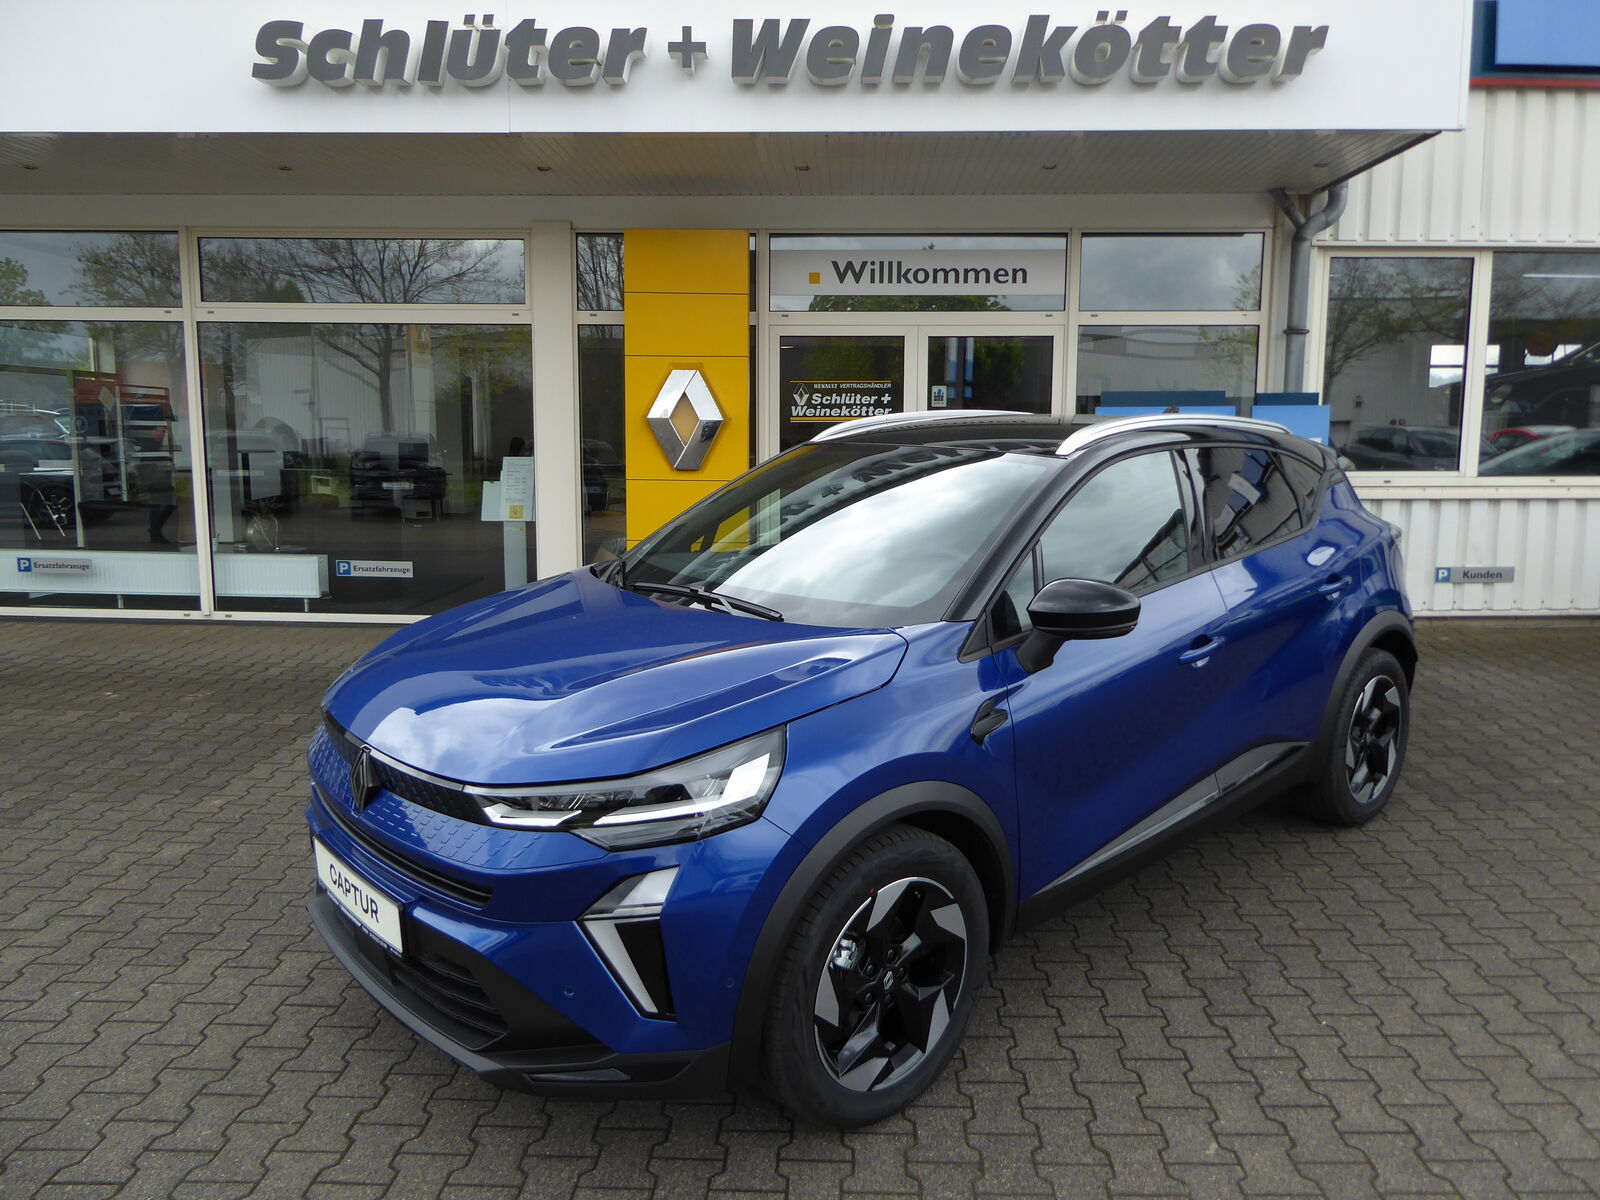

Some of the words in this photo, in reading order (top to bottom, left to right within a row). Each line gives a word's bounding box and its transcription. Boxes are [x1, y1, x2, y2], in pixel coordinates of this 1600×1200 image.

[252, 14, 648, 87] Schlüter
[668, 26, 708, 74] +
[731, 10, 1329, 86] Weinekötter
[831, 260, 1028, 284] Willkommen
[811, 393, 878, 404] Schlüter
[880, 393, 892, 404] +
[791, 405, 892, 417] Weinekötter
[19, 559, 29, 571] P
[33, 561, 90, 571] Ersatzfahrzeuge
[339, 562, 349, 574] P
[353, 565, 411, 574] Ersatzfahrzeuge
[1438, 569, 1448, 580] P
[1462, 569, 1503, 579] Kunden
[329, 863, 379, 924] CAPTUR
